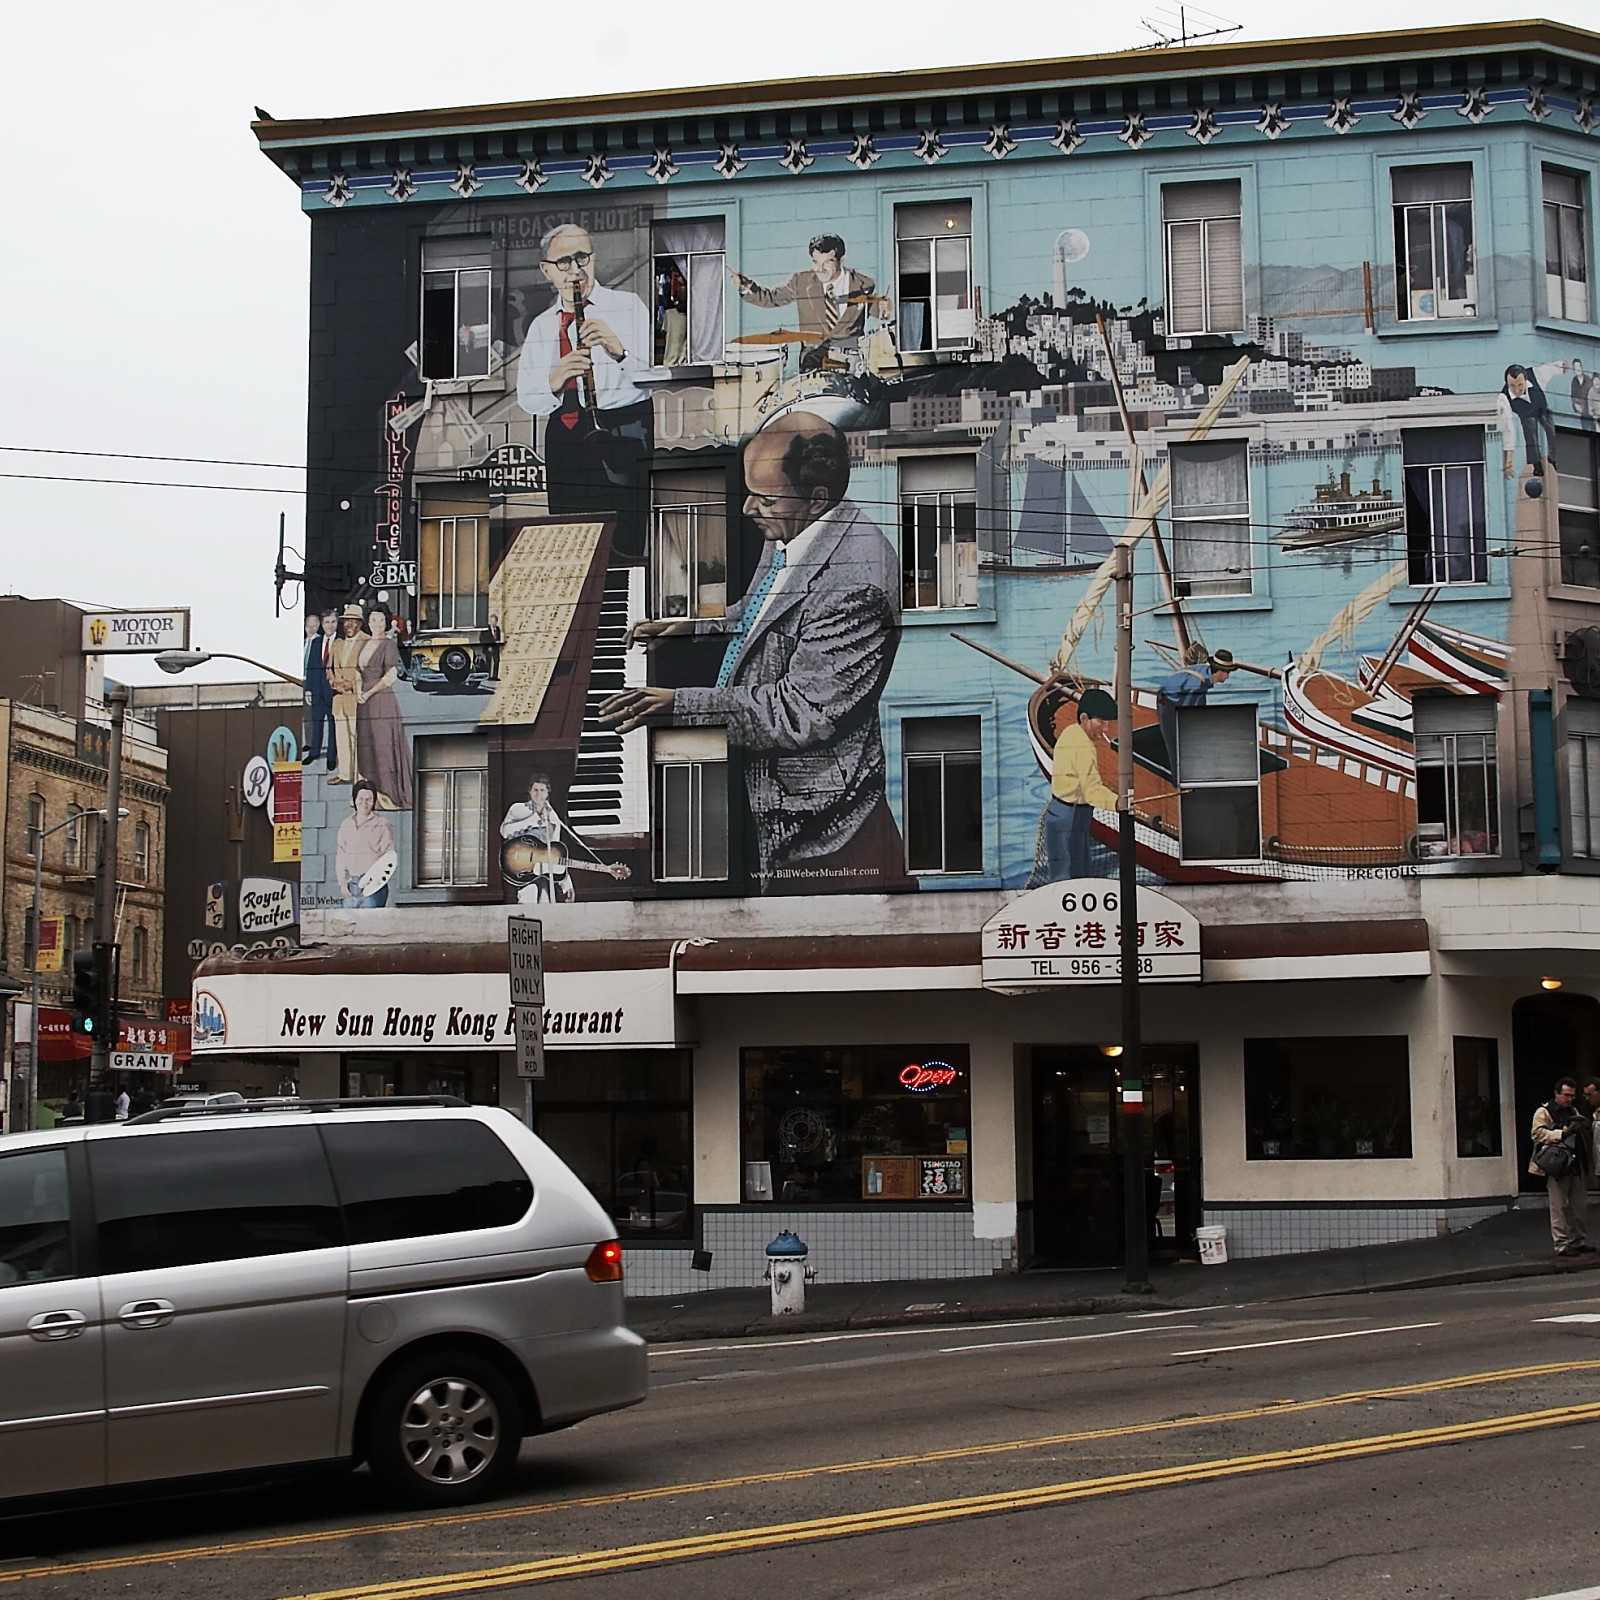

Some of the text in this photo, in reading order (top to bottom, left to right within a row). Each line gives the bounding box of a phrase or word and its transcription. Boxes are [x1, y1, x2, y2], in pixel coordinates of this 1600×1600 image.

[490, 217, 516, 234] THE
[595, 206, 648, 230] HOTEL
[390, 405, 402, 549] MULIN ROUGE
[112, 617, 174, 632] MOTOR
[126, 632, 160, 645] INN
[750, 866, 880, 880] www.BillWeberMuralist.com
[1346, 866, 1418, 880] PRECIOUS
[243, 884, 287, 909] Royal
[301, 896, 344, 906] Bill Weber
[1061, 892, 1118, 912] 606
[242, 905, 292, 930] Pacific
[511, 927, 539, 946] RIGHT
[512, 952, 540, 971] TURN
[1030, 958, 1153, 975] TEL. 956-38
[513, 977, 541, 996] ONLY
[280, 1006, 624, 1042] New Sun Hong Kong Rtaurant
[522, 1011, 537, 1026] NO
[521, 1029, 538, 1042] TURN
[525, 1045, 536, 1057] ON
[114, 1054, 169, 1067] GRANT
[524, 1061, 538, 1073] RED
[900, 1063, 956, 1087] Open
[922, 1160, 961, 1169] TSINGTAO
